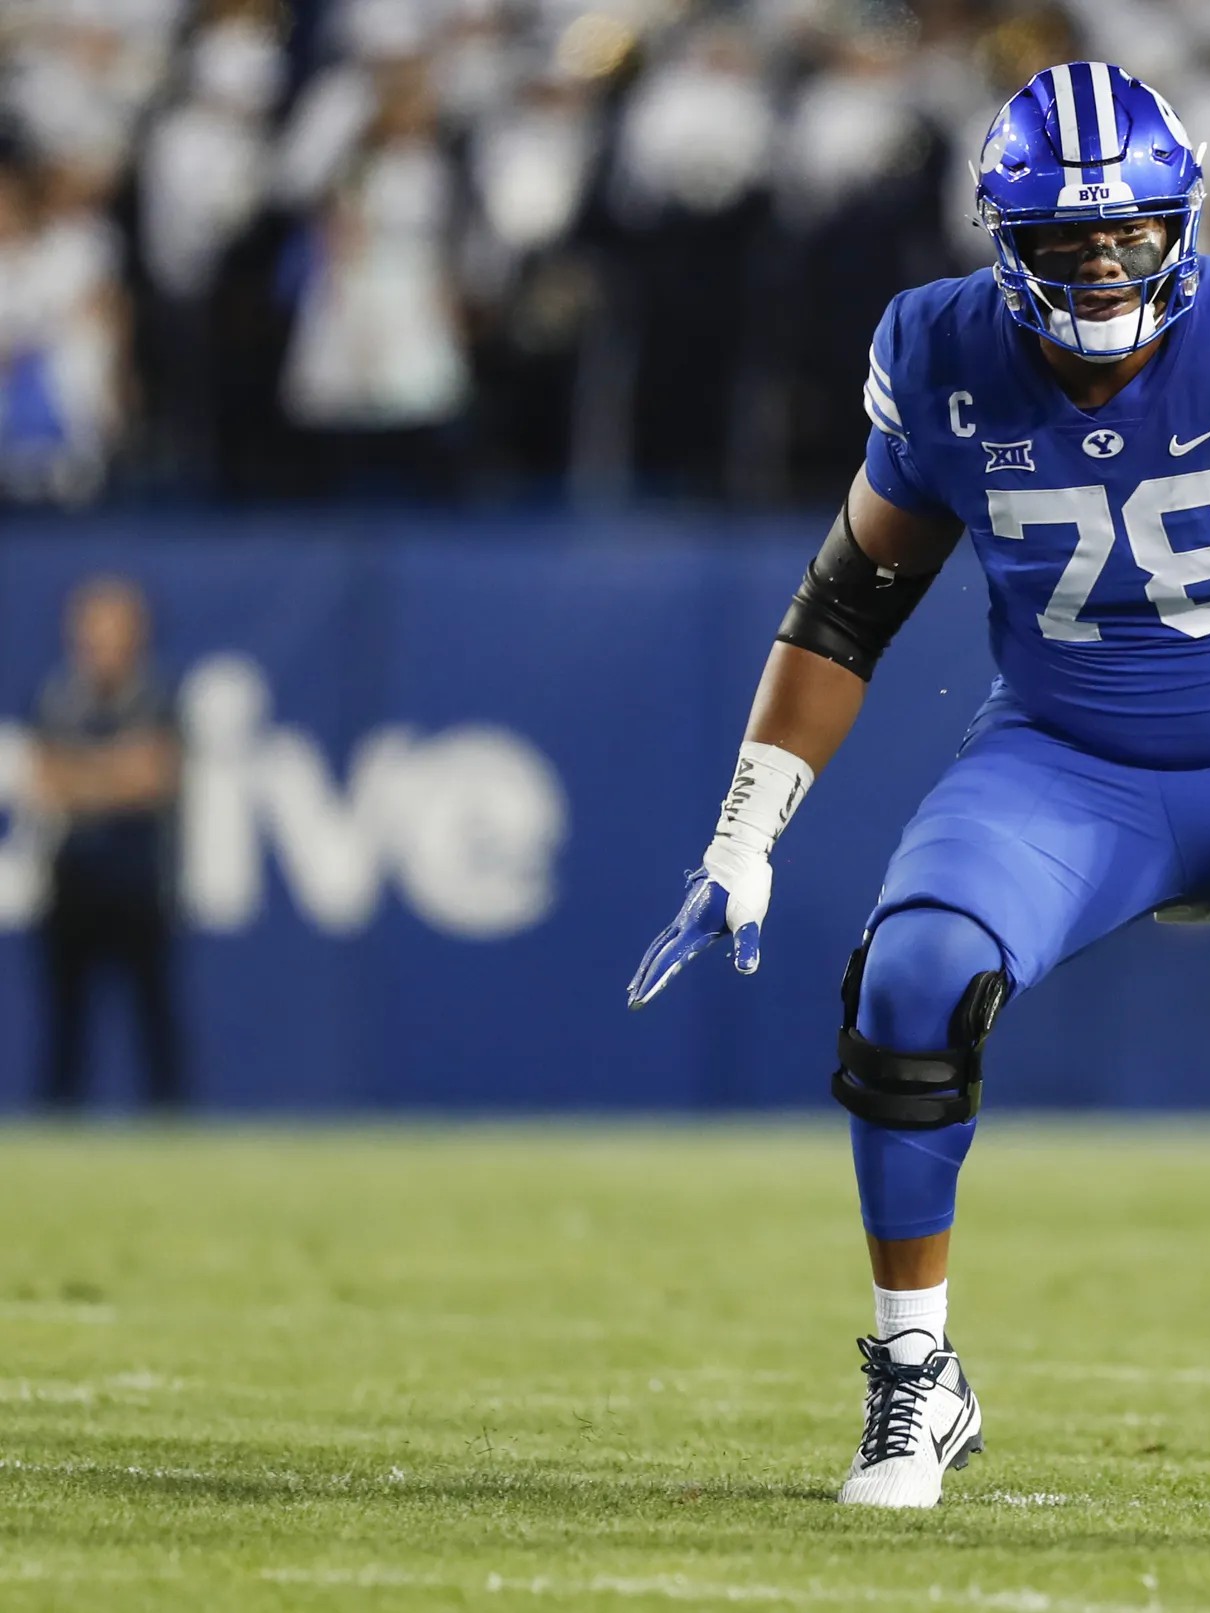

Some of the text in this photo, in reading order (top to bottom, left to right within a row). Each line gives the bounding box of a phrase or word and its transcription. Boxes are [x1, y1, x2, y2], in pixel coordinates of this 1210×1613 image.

[1079, 186, 1109, 202] BYU
[948, 390, 976, 438] C
[1086, 432, 1117, 456] Y
[987, 444, 1033, 471] XII
